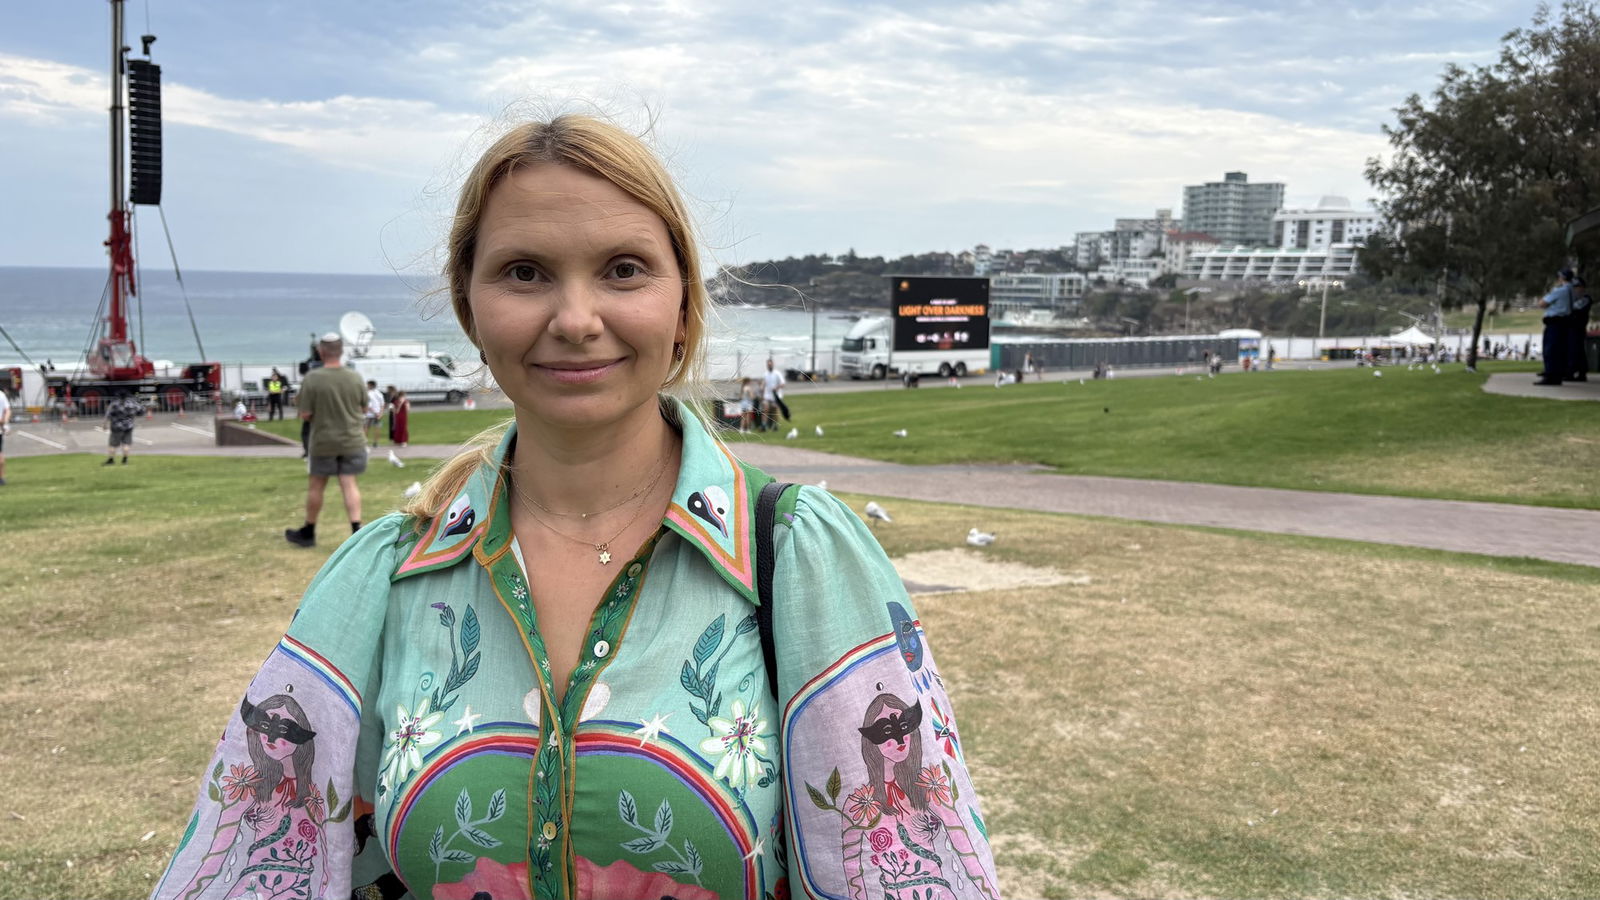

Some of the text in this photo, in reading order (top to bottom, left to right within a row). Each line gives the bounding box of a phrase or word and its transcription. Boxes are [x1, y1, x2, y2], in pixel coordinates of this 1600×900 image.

[899, 305, 984, 316] LIGHT OVER DARKNESS
